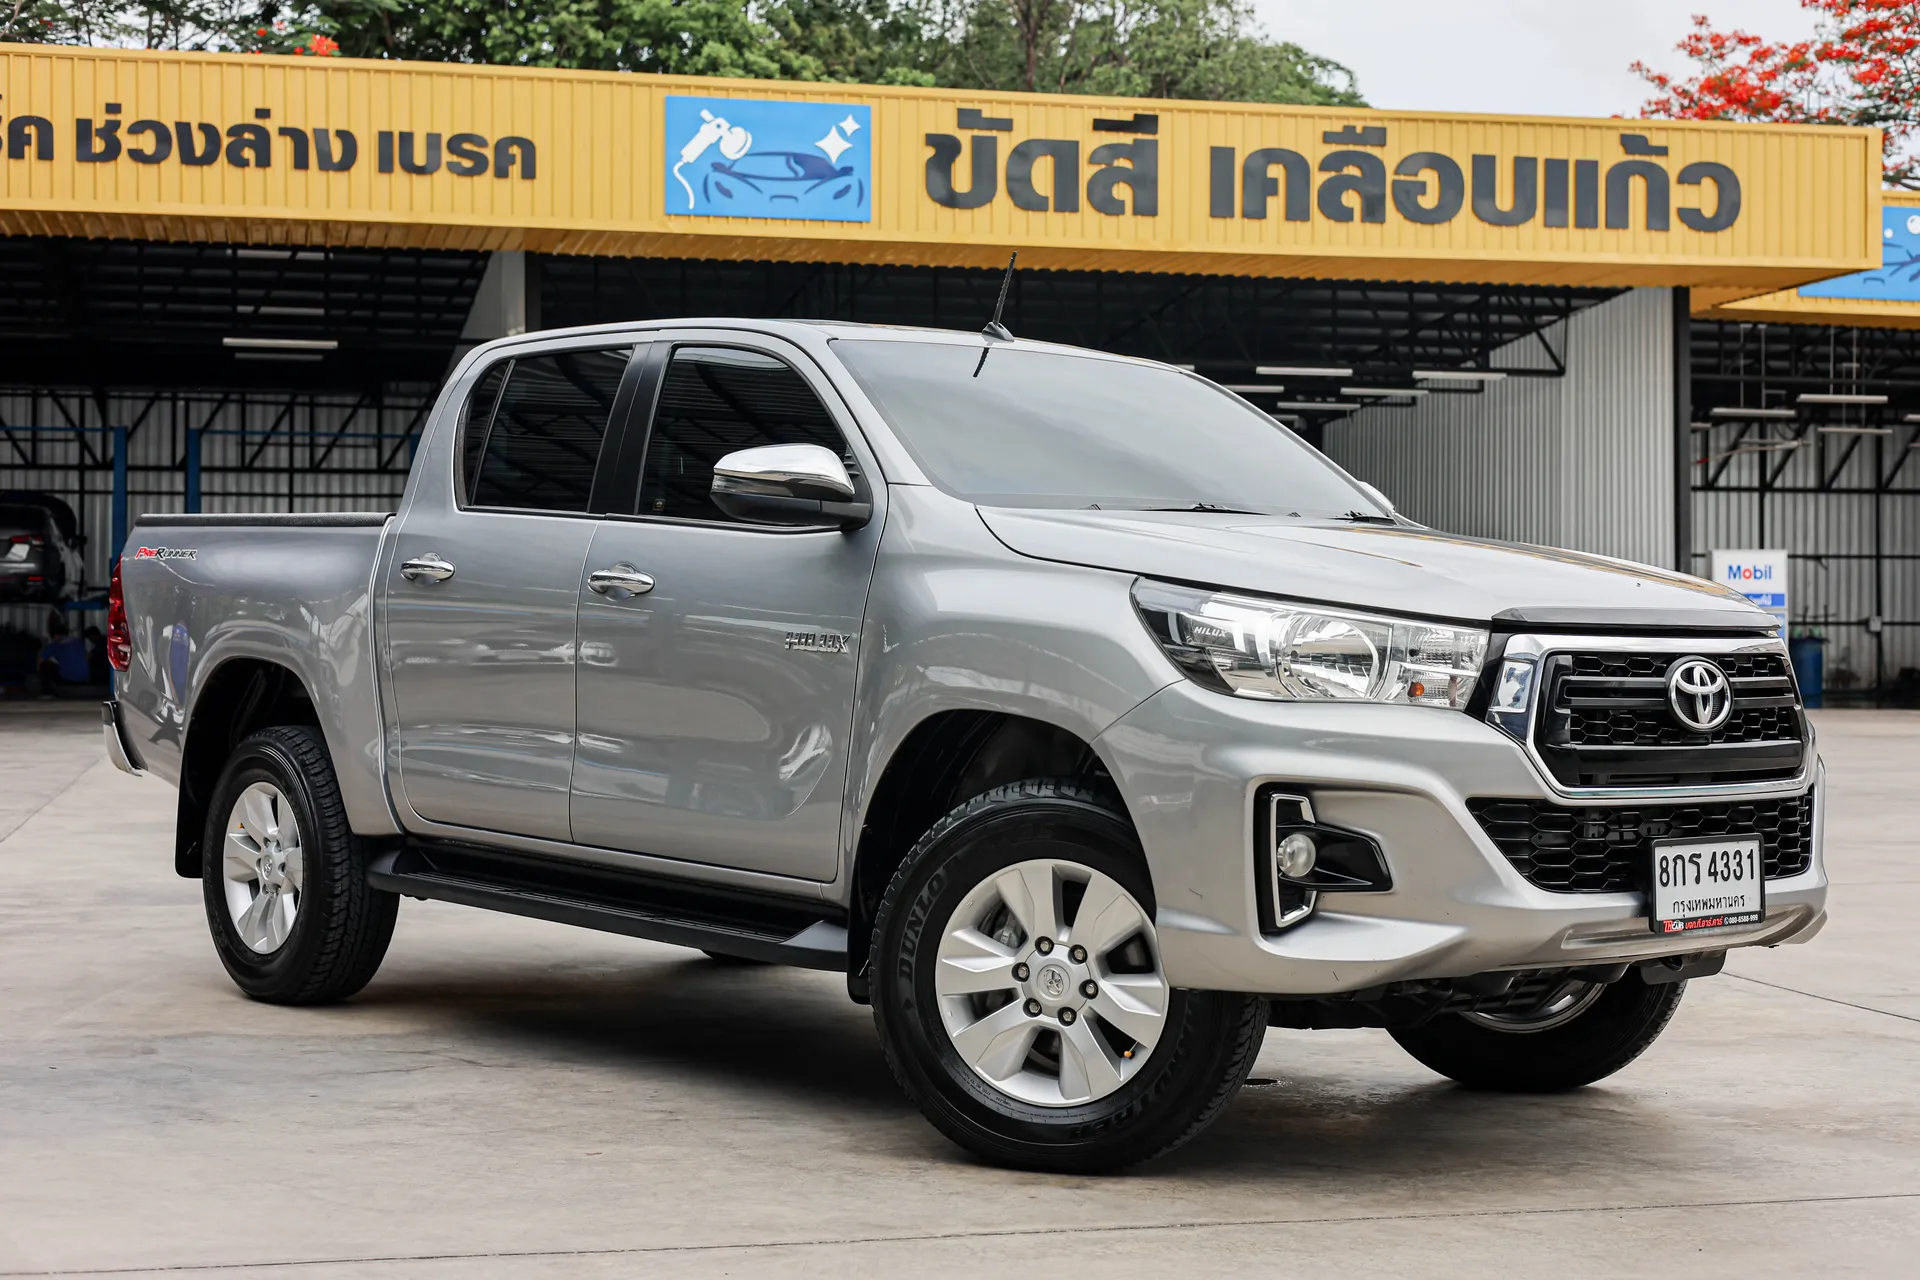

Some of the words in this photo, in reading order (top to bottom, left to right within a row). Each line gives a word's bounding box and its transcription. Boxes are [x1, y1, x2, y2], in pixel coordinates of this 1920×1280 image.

[75, 102, 358, 172] ช่วงล่าง
[378, 130, 537, 180] เบรค
[925, 108, 1158, 217] ขัดสี
[1209, 125, 1742, 233] เคลือบแก้ว
[1728, 565, 1772, 579] Mobil
[784, 631, 851, 654] HILUX
[1194, 626, 1228, 637] HILUX
[1659, 852, 1702, 888] 8กร
[1707, 848, 1754, 883] 4331
[898, 855, 958, 986] DUNLO
[1672, 894, 1745, 918] กรุงเทพมหานคร
